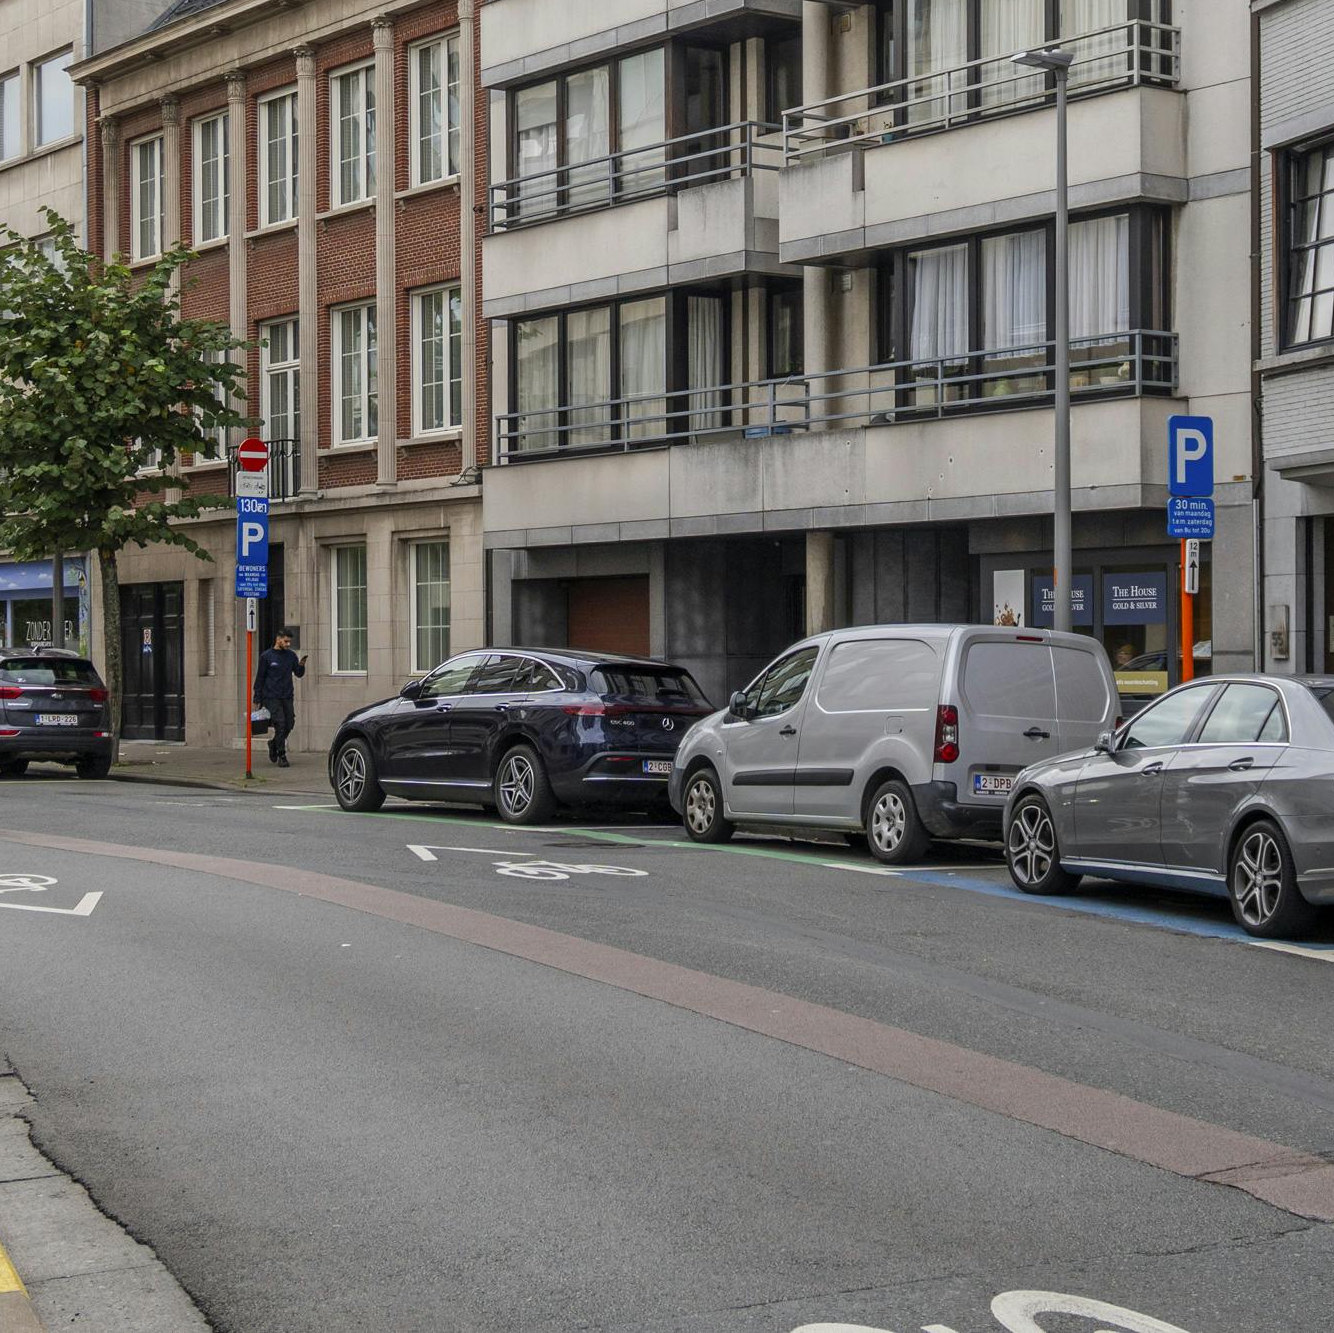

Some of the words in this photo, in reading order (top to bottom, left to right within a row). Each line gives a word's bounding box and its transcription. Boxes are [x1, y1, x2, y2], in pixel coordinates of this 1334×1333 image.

[1176, 428, 1207, 483] P
[1175, 499, 1187, 510] 30
[1189, 500, 1208, 510] min.
[1185, 510, 1211, 518] maandag
[1187, 518, 1213, 526] zaterdag
[242, 522, 264, 556] P
[1190, 542, 1198, 551] 12
[1041, 589, 1054, 599] TH
[1071, 590, 1085, 598] USE
[1112, 602, 1129, 610] GOLD
[1129, 601, 1136, 609] &
[1136, 601, 1157, 609] SILVER
[26, 620, 51, 641] ZONDER
